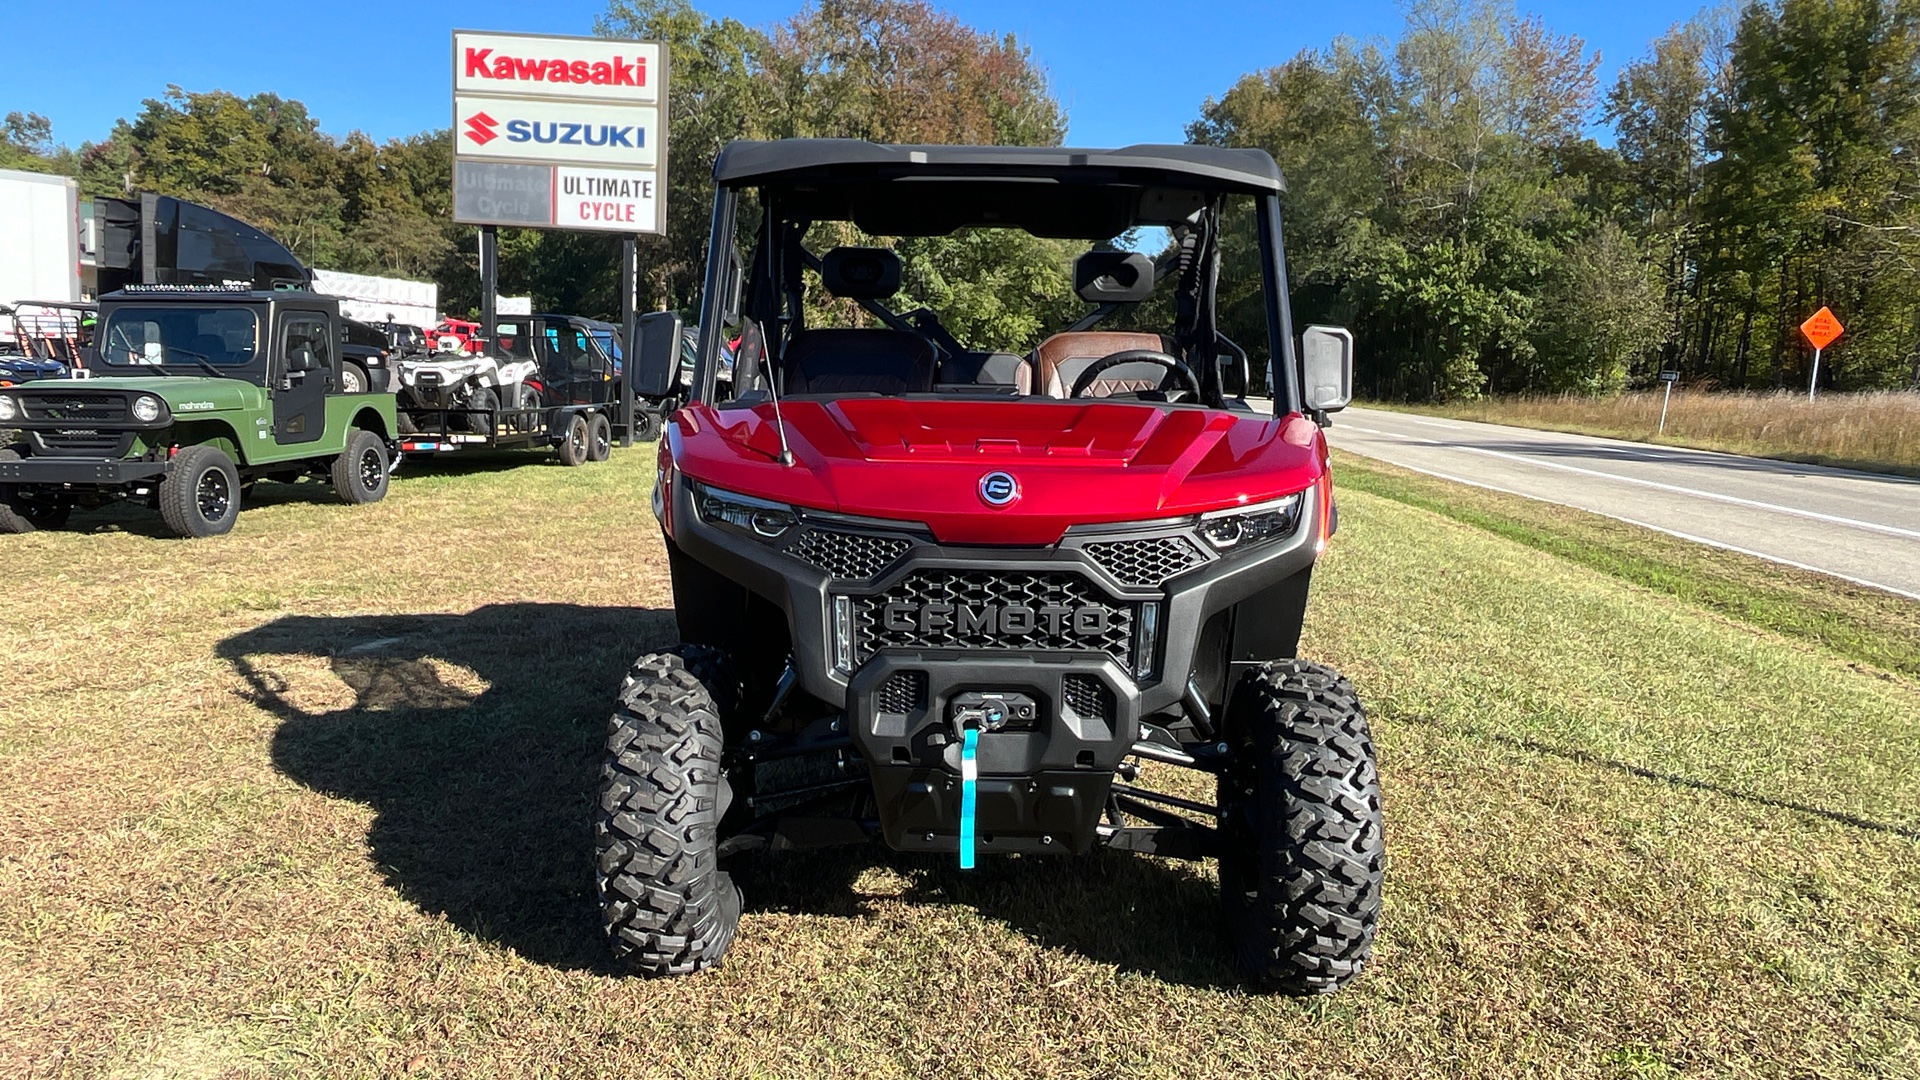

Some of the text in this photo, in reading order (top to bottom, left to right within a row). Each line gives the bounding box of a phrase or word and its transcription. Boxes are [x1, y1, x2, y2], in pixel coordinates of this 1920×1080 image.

[465, 47, 647, 87] Kawasaki
[506, 119, 645, 148] SUZUKI
[563, 175, 652, 199] ULTIMATE
[579, 201, 636, 222] CYCLE
[178, 401, 215, 410] mahindra
[884, 602, 1108, 635] CFMOTO
